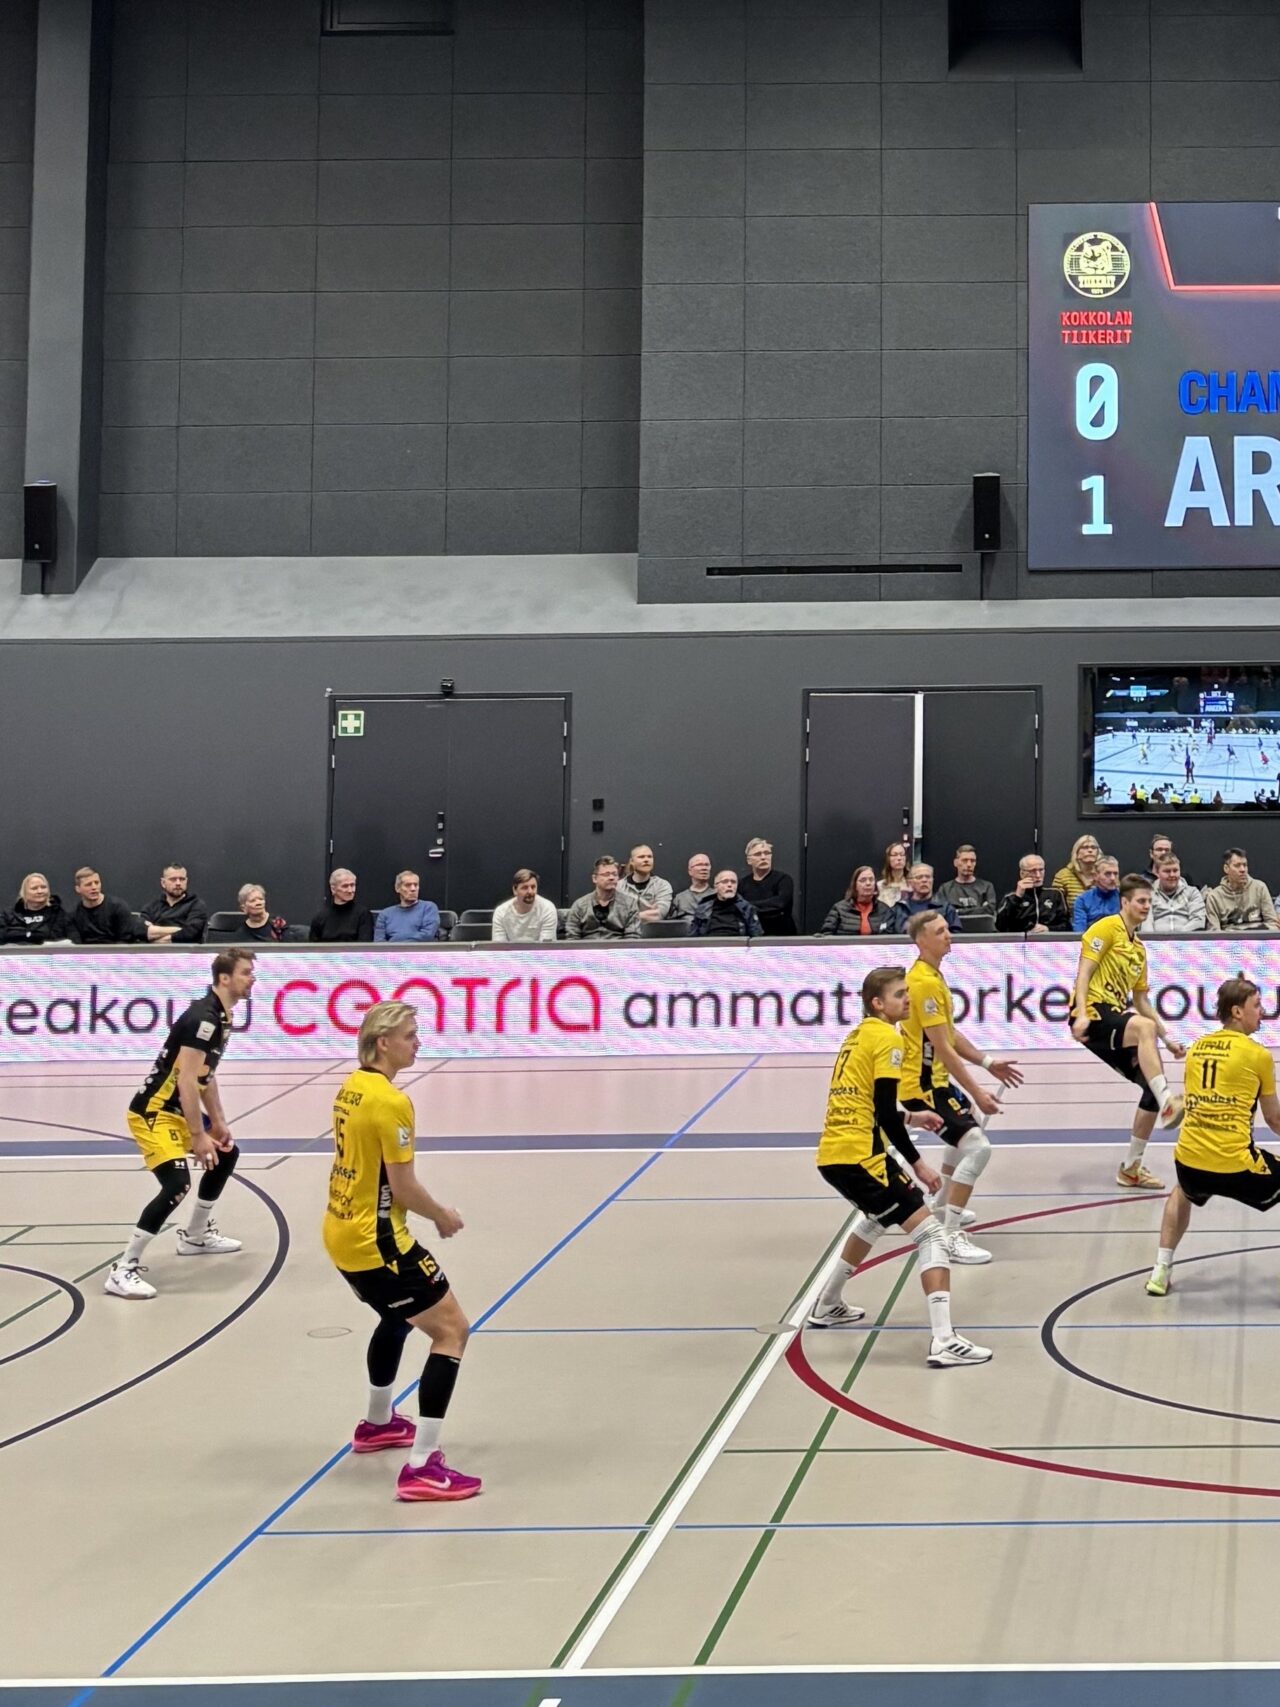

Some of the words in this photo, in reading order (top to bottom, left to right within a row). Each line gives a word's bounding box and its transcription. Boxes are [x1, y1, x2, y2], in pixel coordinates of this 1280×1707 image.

[1061, 311, 1132, 326] KOKKOLAN
[1061, 330, 1132, 344] TIIKERIT
[1076, 362, 1119, 440] 0
[1081, 475, 1113, 535] 1
[1202, 1058, 1217, 1089] 11
[417, 1254, 437, 1277] 15
